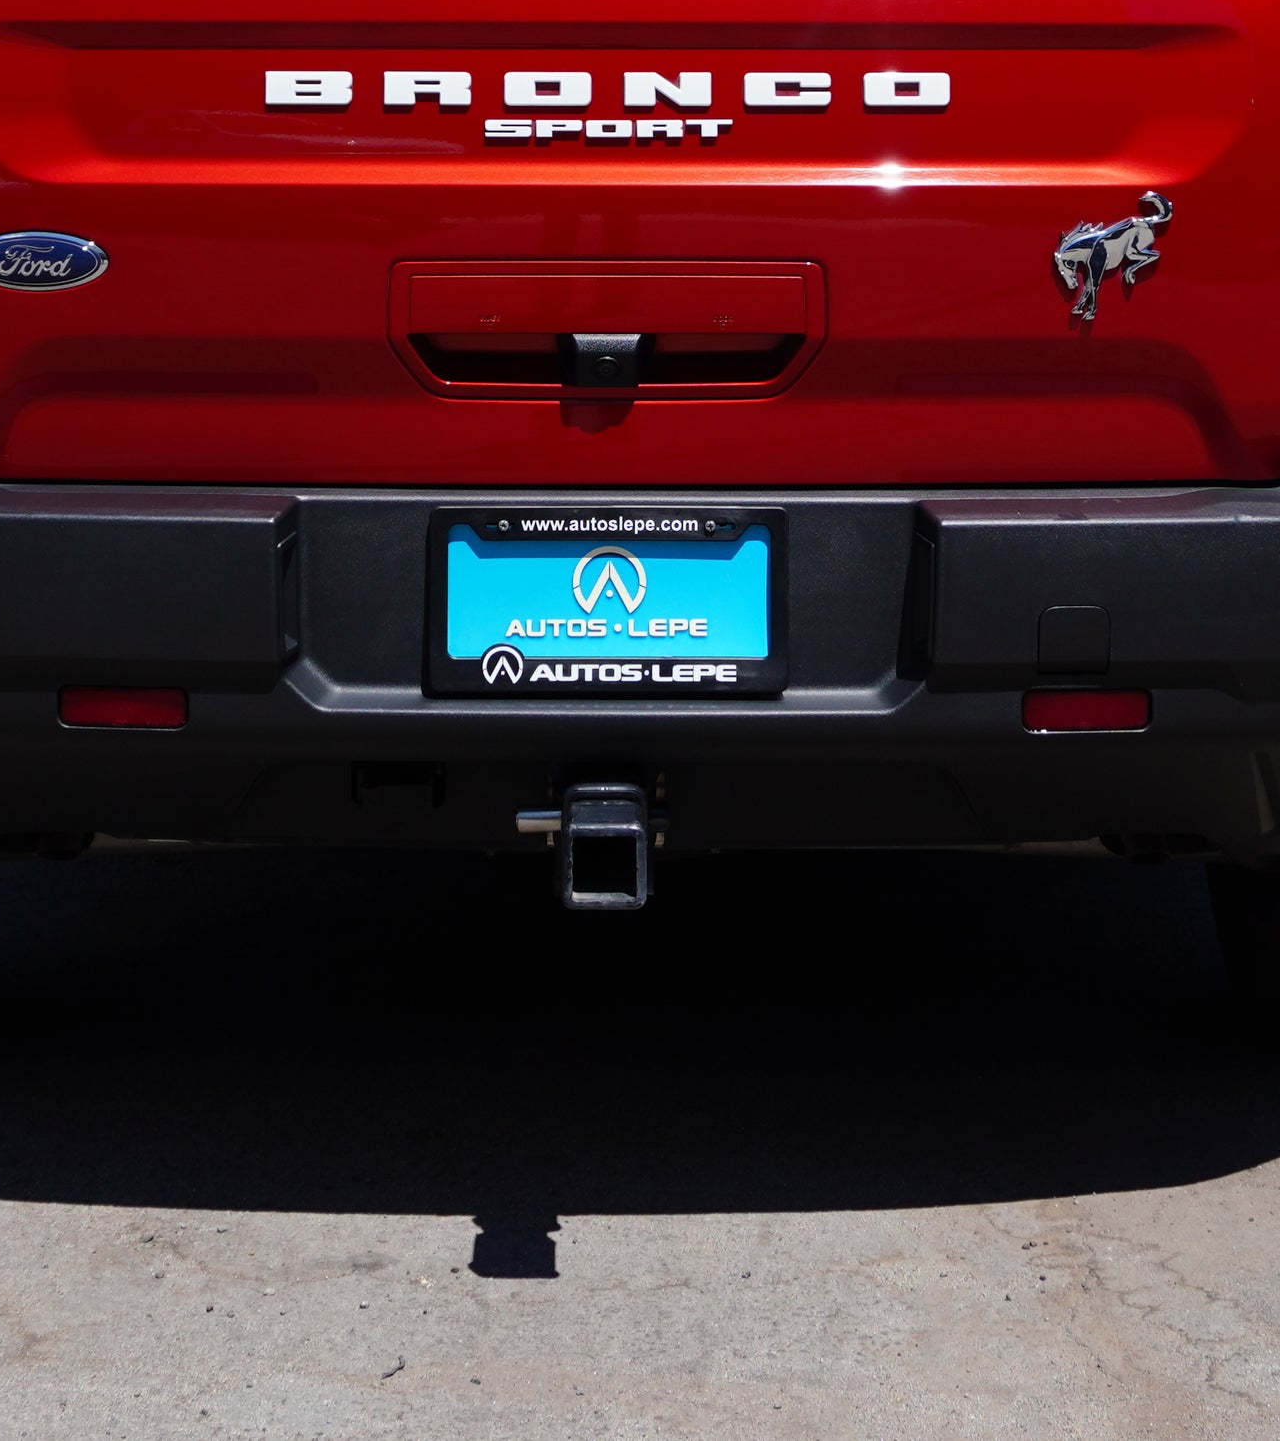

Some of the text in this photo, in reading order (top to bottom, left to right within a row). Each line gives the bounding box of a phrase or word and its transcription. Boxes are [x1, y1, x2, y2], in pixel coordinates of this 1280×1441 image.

[265, 70, 951, 107] BRONCO
[484, 119, 733, 139] SPORT
[521, 515, 699, 534] www.autoslepe.com
[505, 618, 709, 638] AUTOS LEPE
